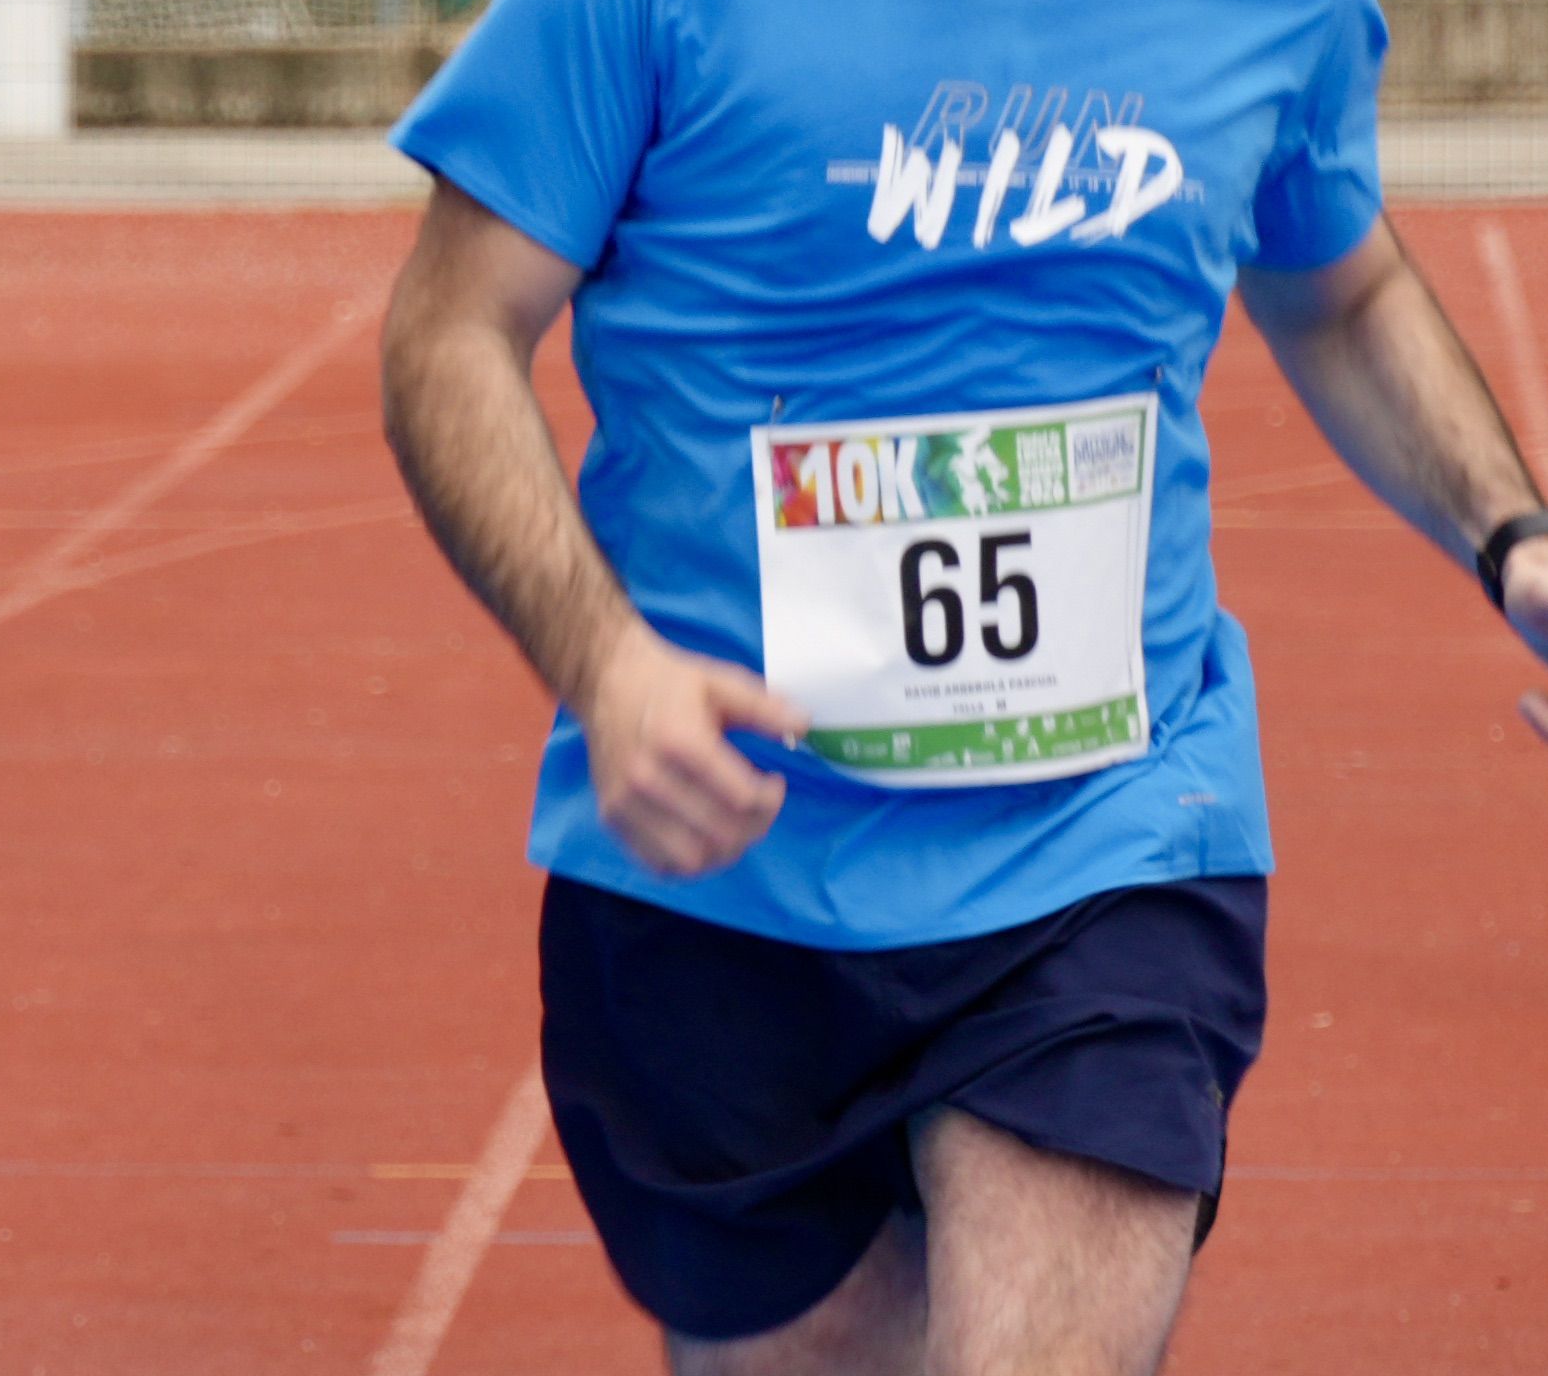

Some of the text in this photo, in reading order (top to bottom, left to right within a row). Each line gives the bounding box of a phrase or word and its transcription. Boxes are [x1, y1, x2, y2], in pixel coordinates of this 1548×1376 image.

[866, 122, 1185, 251] WILD
[798, 437, 925, 524] 10K
[899, 529, 1040, 667] 65
